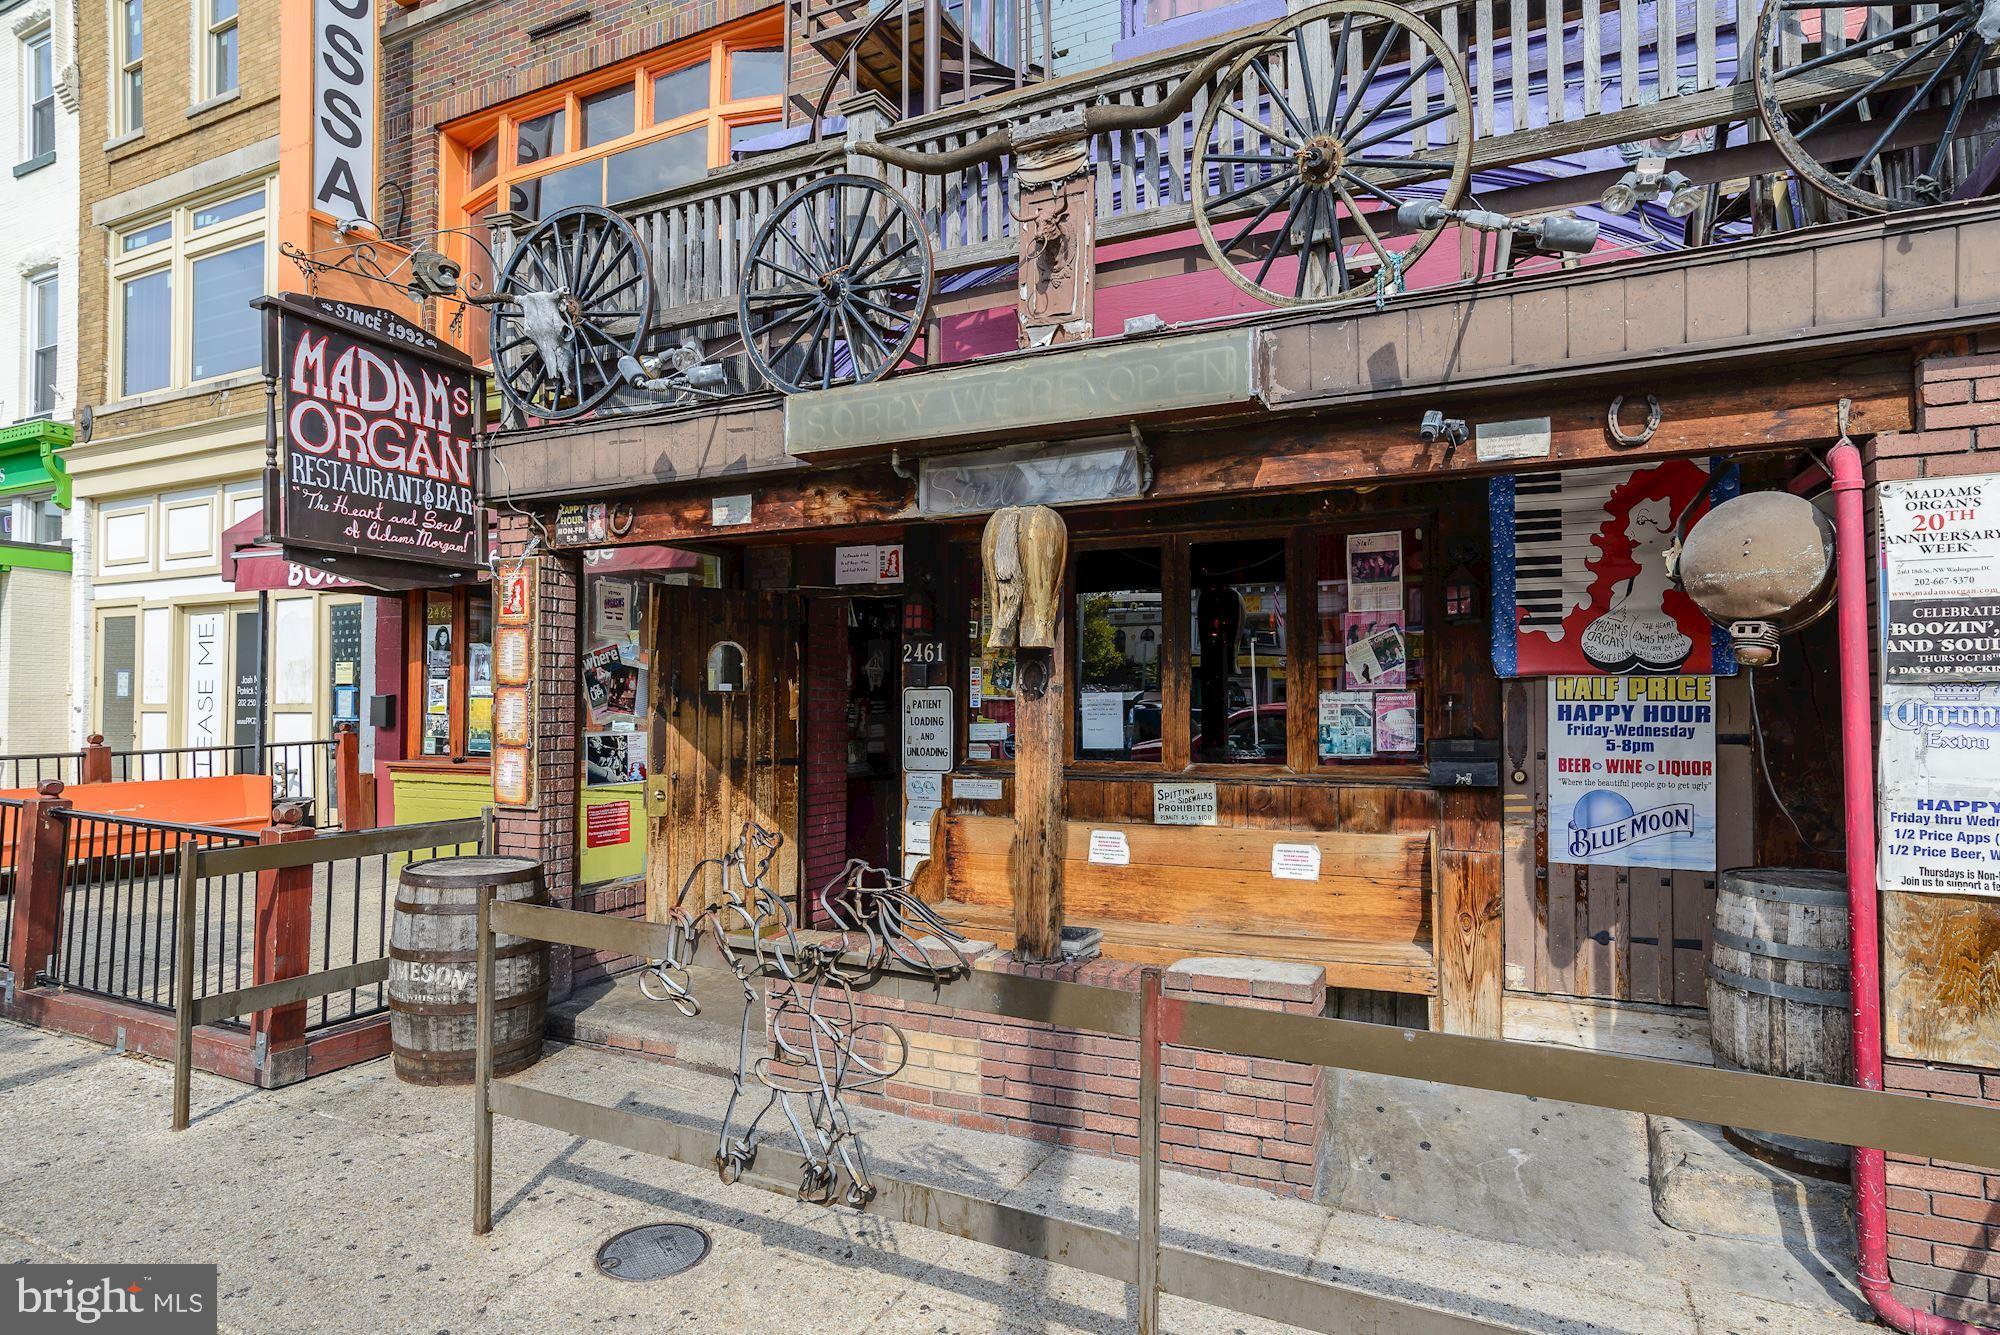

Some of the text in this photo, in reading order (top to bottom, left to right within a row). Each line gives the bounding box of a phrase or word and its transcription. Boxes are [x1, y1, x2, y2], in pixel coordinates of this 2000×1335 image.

[336, 303, 425, 348] SINCE 1992
[806, 388, 932, 441] SORRY
[1100, 345, 1238, 400] OPEN
[289, 399, 471, 486] ORGAN
[291, 452, 425, 505] RESTAURANT
[435, 482, 473, 516] BAR
[1905, 485, 1982, 500] MADAMS
[1905, 496, 1982, 512] ORGAN'S
[332, 495, 385, 522] Heart
[389, 508, 419, 527] and
[422, 511, 463, 534] Soul
[560, 515, 584, 525] HOUR
[1911, 508, 1976, 532] 20TH
[343, 519, 361, 539] of
[366, 521, 415, 546] Adams
[557, 526, 586, 535] MON-FRI
[1886, 528, 2000, 545] ANNIVERSARY
[1919, 542, 1969, 554] WEEK
[1914, 576, 1975, 586] 202-667-5370
[1912, 605, 2000, 619] CELEBRATE
[1655, 620, 1676, 630] HEART
[1586, 631, 1625, 649] ORGAN
[1886, 639, 1934, 653] AND
[583, 644, 620, 670] where
[903, 642, 944, 662] 2461
[1918, 654, 1955, 663] THURS
[1956, 653, 1980, 662] OCT
[1888, 666, 1897, 675] 4
[1899, 666, 1931, 675] DAYS
[1934, 665, 1952, 674] OF
[1555, 676, 1712, 702] HALF PRICE
[912, 699, 942, 709] PATIENT
[910, 716, 944, 726] LOADING
[1557, 704, 1711, 723] HAPPY HOUR
[1888, 697, 2000, 735] Coron
[920, 732, 935, 741] AND
[1567, 723, 1696, 740] Friday-Wednesday
[1605, 739, 1655, 754] 5-8pm
[1926, 730, 1990, 750] Extra
[906, 747, 949, 757] UNLOADING
[1558, 757, 1712, 777] BEER WINE LIQUOR
[1584, 779, 1596, 787] the
[1597, 779, 1630, 787] beautiful
[1631, 780, 1655, 790] people
[1657, 782, 1666, 790] go
[1677, 781, 1690, 790] get
[1157, 788, 1195, 801] SPITTING
[1178, 792, 1213, 804] SIDEWALKS
[1158, 803, 1213, 812] PROHIBITED
[1917, 799, 2000, 813] HAPPY
[1890, 812, 1931, 826] Friday
[1935, 813, 1962, 825] thru
[1569, 808, 1689, 858] BLUE MOON
[1894, 828, 1915, 840] 1/2
[1919, 829, 1953, 842] Price
[1957, 831, 1991, 845] Apps
[1889, 844, 1909, 856] 1/2
[1913, 845, 1947, 858] Price
[1951, 847, 1985, 861] Beer,
[1919, 866, 1965, 881] Thursdays
[1967, 869, 1975, 879] is
[1901, 875, 1920, 886] Join
[1935, 879, 1944, 887] to
[1984, 882, 1990, 891] a
